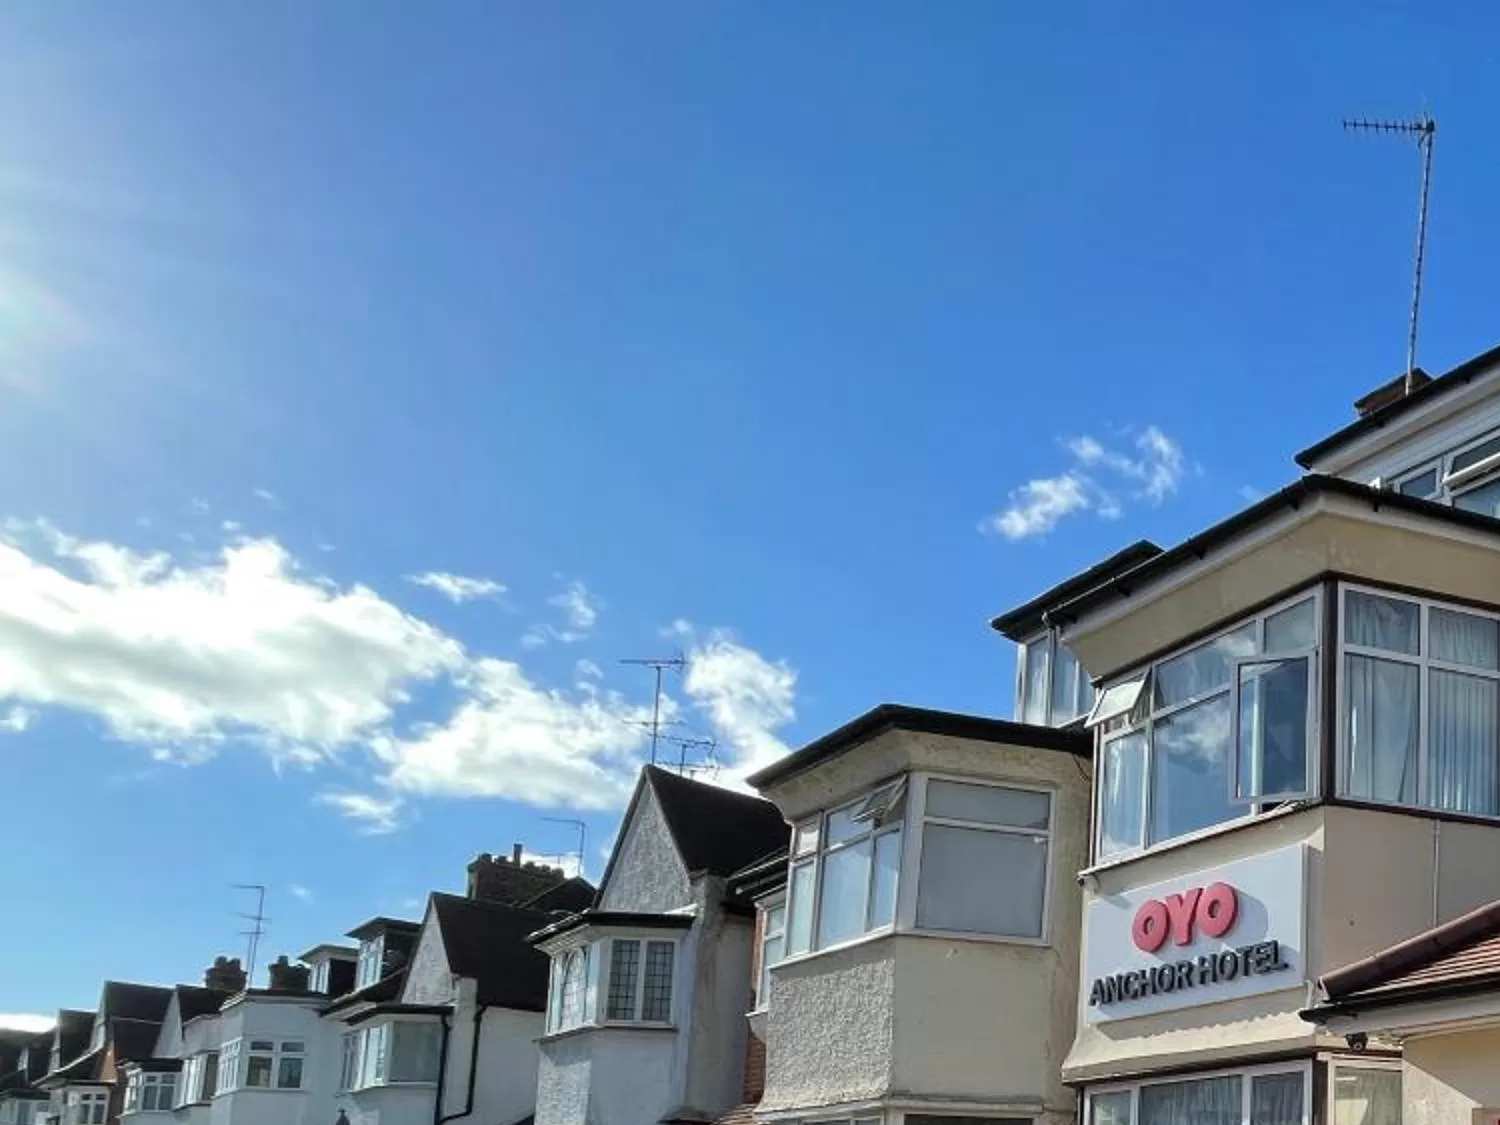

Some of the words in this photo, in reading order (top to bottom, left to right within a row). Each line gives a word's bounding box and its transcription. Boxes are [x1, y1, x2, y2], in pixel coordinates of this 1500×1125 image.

[1132, 882, 1238, 953] OYO
[1089, 960, 1195, 1007] ANCHOR
[1198, 939, 1290, 985] HOTEL
